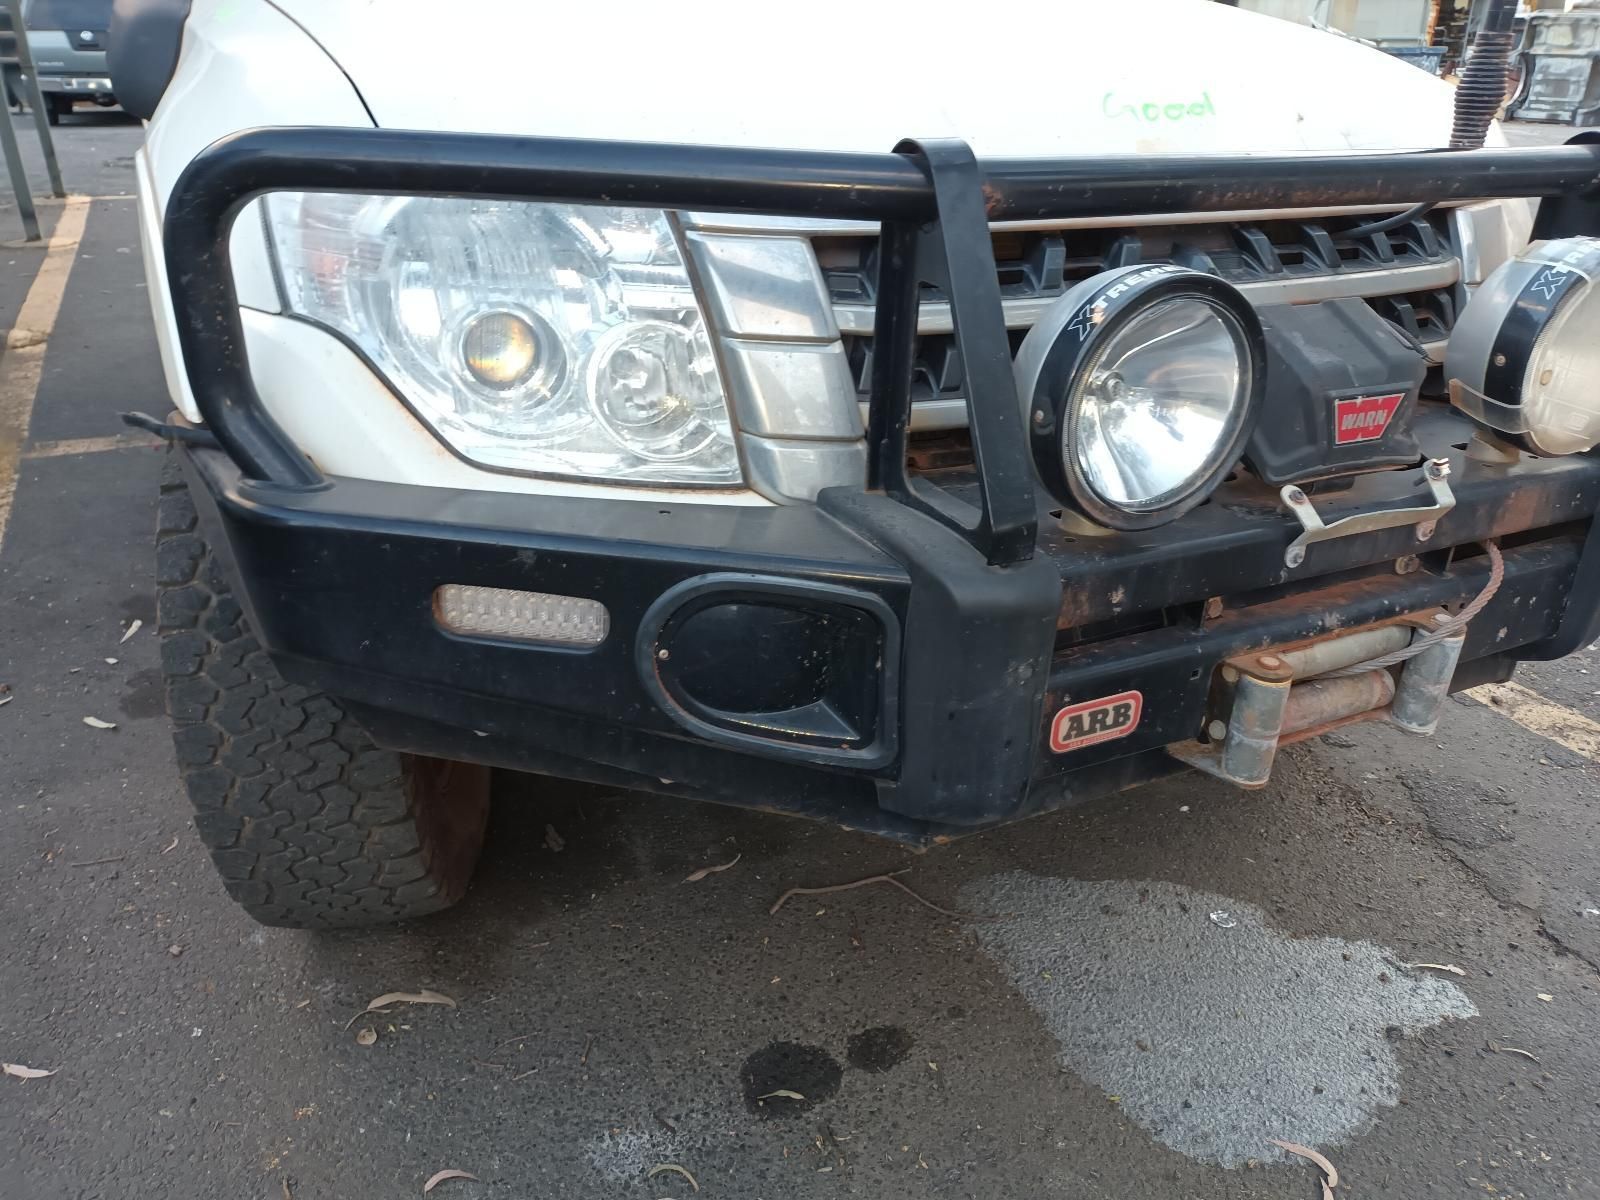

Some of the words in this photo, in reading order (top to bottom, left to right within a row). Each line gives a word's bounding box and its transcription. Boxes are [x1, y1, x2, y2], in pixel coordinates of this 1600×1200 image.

[1102, 91, 1216, 122] Good
[1341, 409, 1388, 431] WARN
[1061, 702, 1132, 742] ARB
